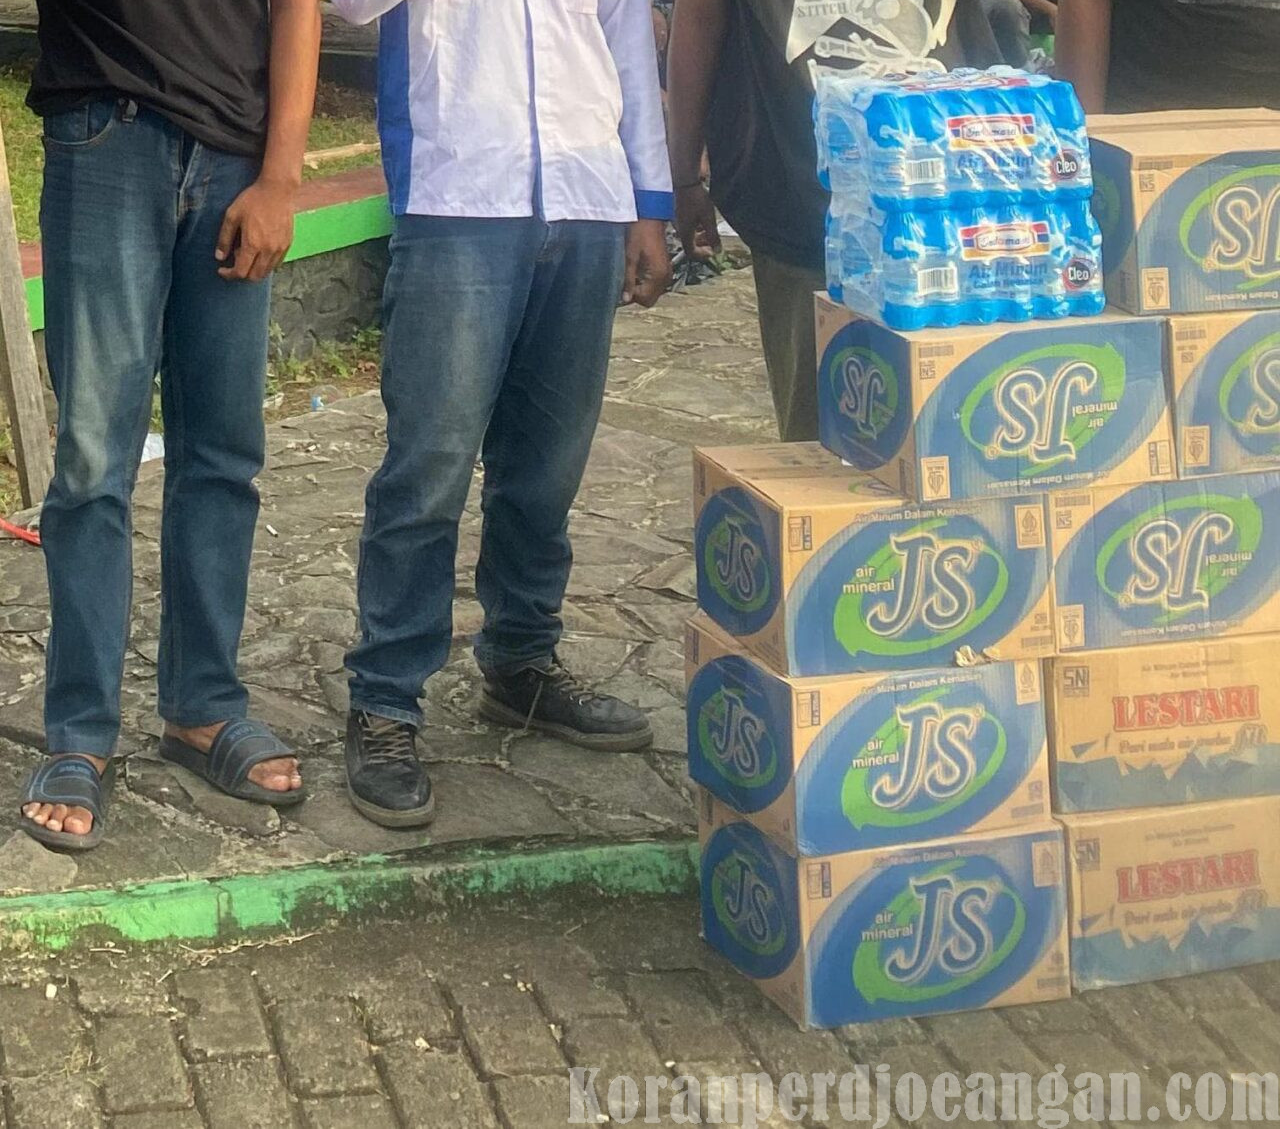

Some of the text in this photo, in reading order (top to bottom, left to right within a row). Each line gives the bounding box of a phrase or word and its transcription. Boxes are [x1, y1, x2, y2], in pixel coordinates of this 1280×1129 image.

[795, 1, 849, 18] STITCH
[1068, 266, 1089, 281] Cleo
[995, 360, 1098, 463] JS
[1071, 401, 1118, 418] mineral
[1129, 512, 1235, 611] JS
[855, 565, 875, 578] air
[842, 579, 895, 595] mineral
[866, 531, 974, 637] JS
[1112, 685, 1261, 732] LESTARI
[866, 738, 884, 752] air
[851, 752, 900, 770] mineral
[871, 701, 976, 809] JS
[1116, 848, 1262, 904] LESTARI
[874, 910, 894, 924] air
[861, 924, 914, 942] mineral
[884, 874, 992, 984] JS
